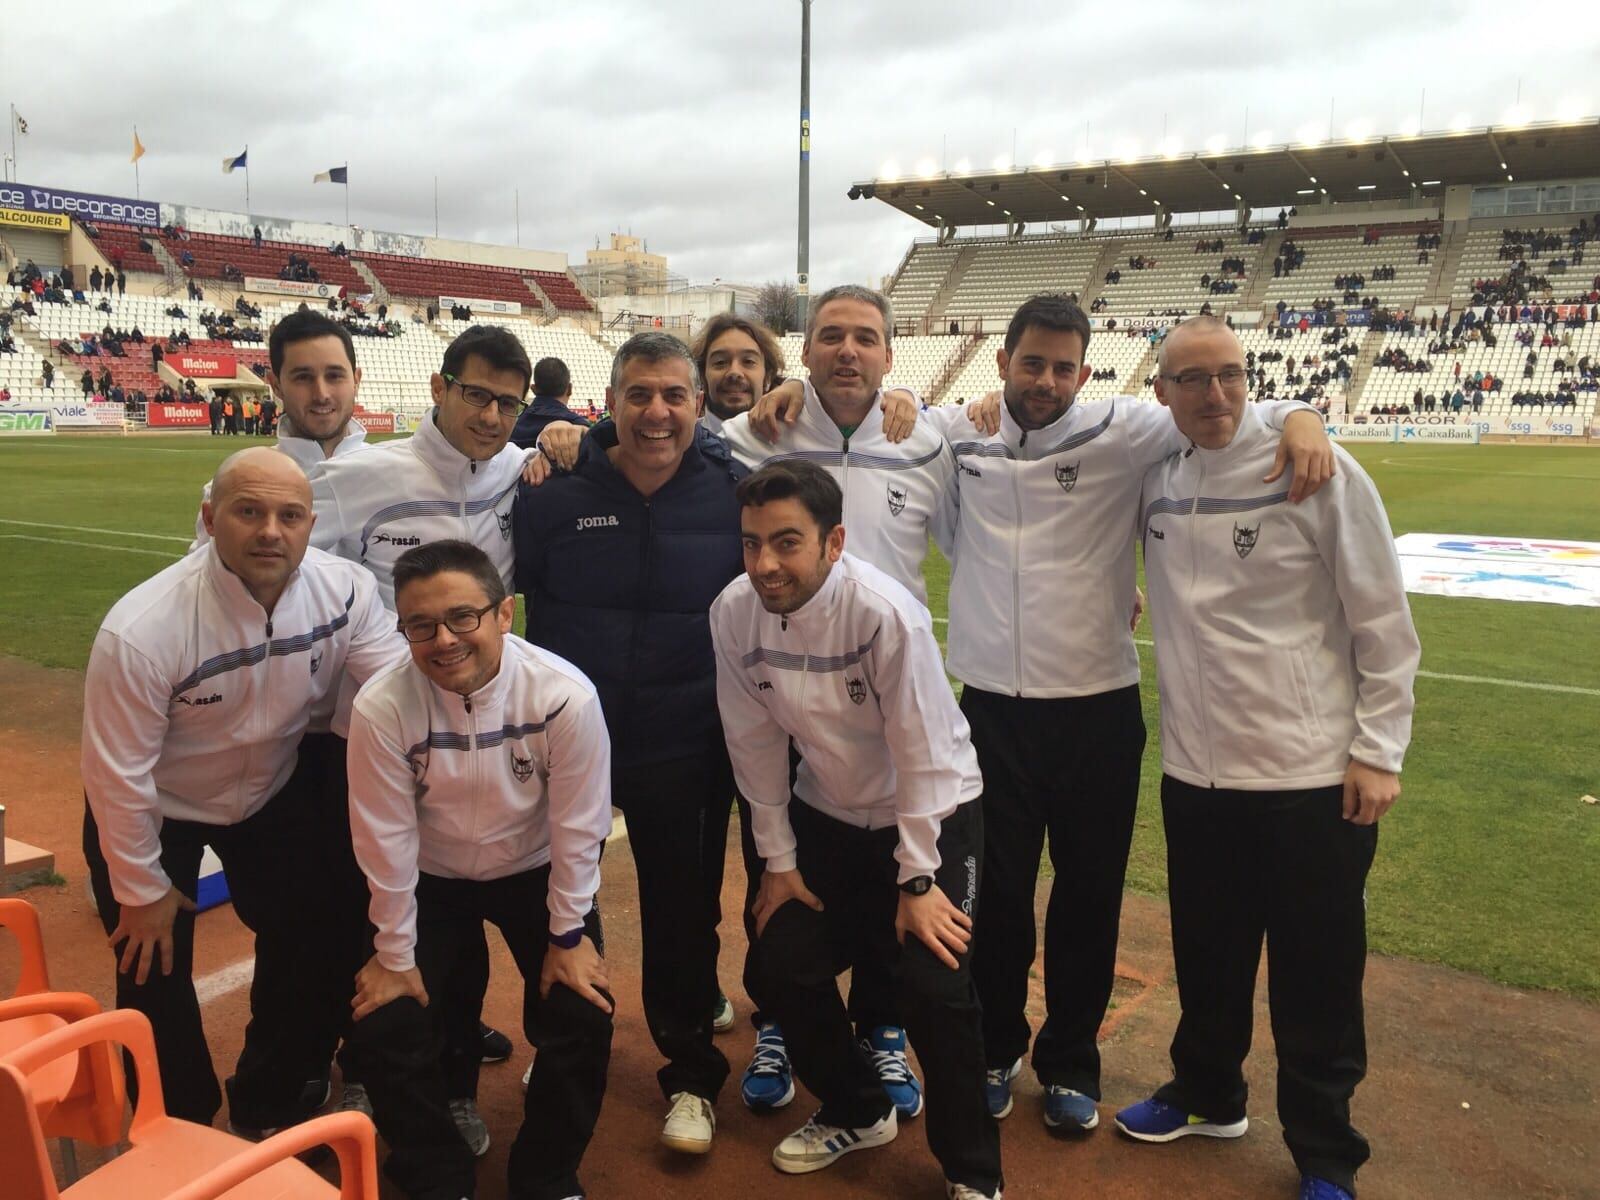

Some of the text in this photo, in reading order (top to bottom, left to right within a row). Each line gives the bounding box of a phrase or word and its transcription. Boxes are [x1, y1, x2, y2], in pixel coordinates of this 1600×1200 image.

[182, 358, 219, 369] Mahou
[163, 406, 203, 418] Mahou
[358, 417, 391, 426] PORTIUM
[1374, 416, 1456, 425] ARACOR
[1339, 426, 1391, 438] CaixaBank
[1418, 427, 1473, 439] CaixaBank
